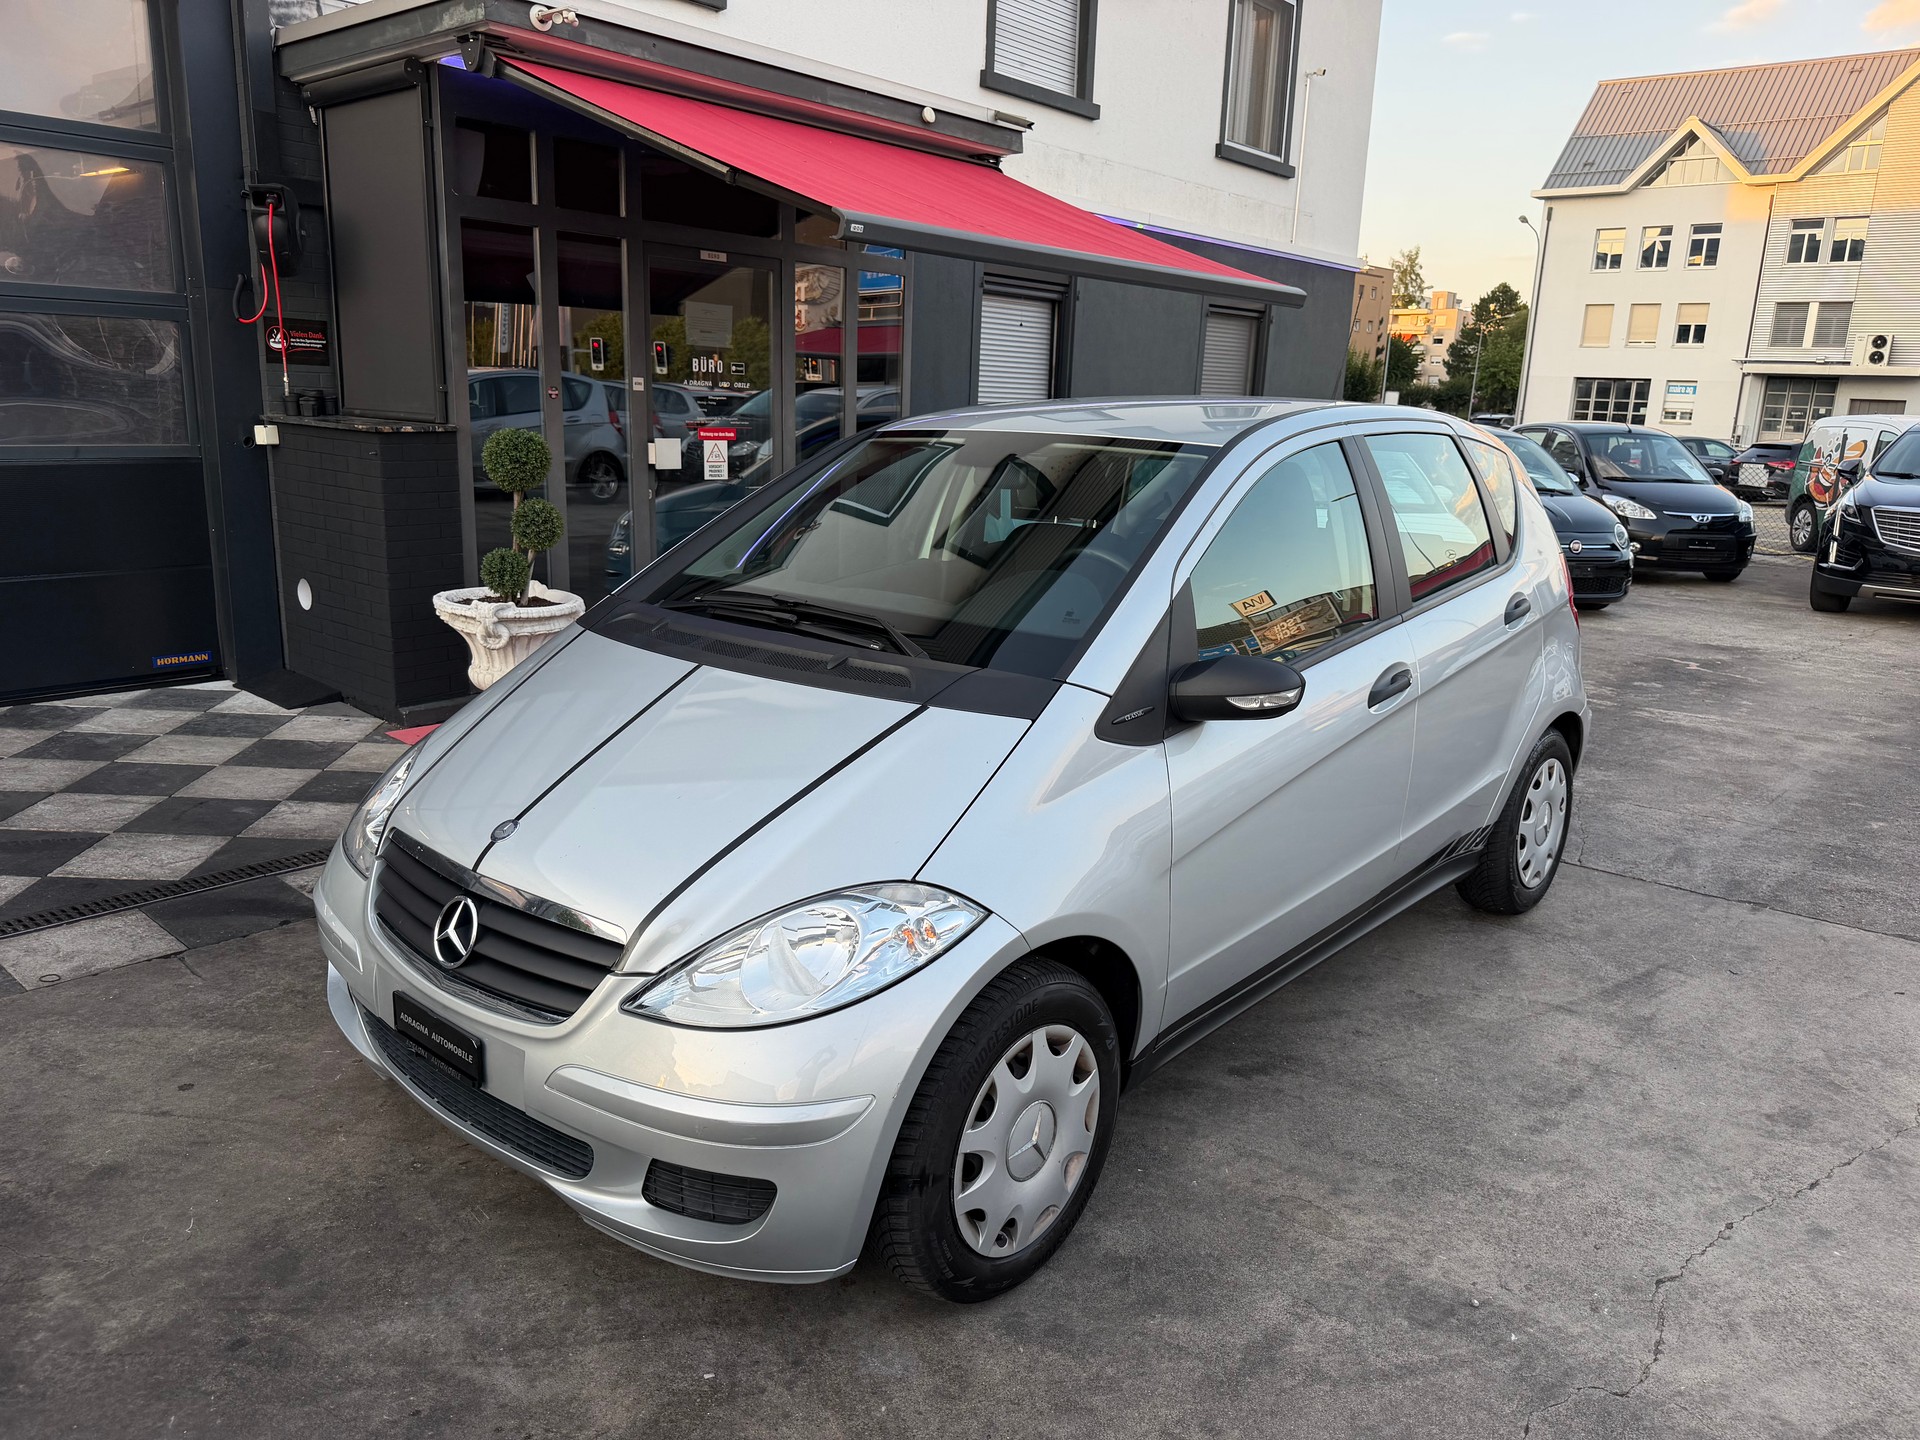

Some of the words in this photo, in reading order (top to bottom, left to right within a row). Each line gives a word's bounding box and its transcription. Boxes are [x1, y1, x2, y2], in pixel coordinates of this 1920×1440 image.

[692, 356, 724, 374] BÜRO
[157, 653, 209, 666] HÖRMANN
[400, 1012, 429, 1036] ADRAGNA
[431, 1032, 473, 1064] AUTOMOBILE
